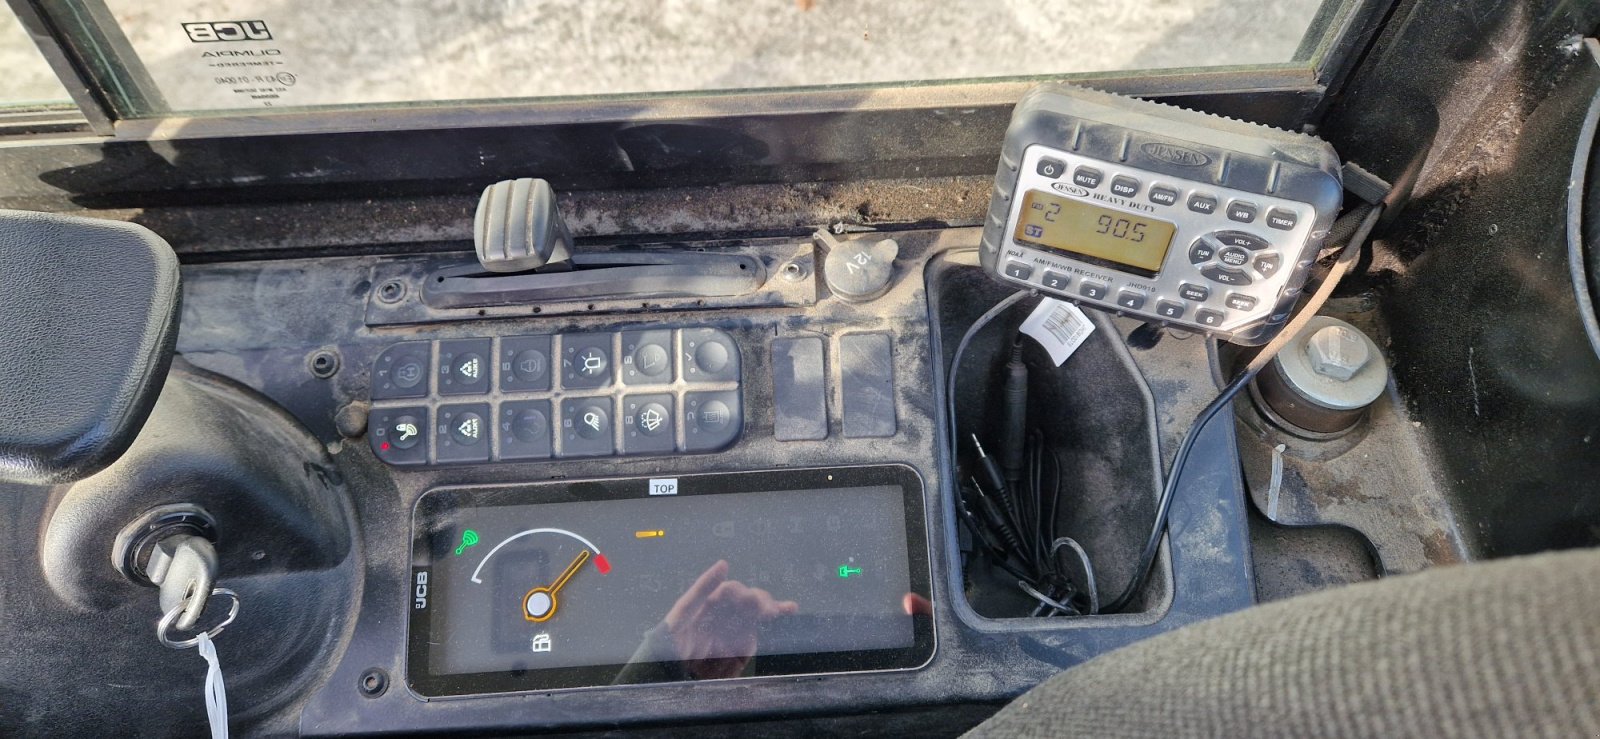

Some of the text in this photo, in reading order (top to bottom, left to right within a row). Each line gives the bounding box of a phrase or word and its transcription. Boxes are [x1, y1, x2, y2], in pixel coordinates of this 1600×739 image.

[1076, 175, 1097, 185] MUTE
[1057, 184, 1084, 195] JENSEN
[1114, 185, 1135, 194] DISP
[1152, 193, 1174, 203] AM/FM
[1093, 193, 1157, 213] HEAVY DUTY
[1193, 202, 1211, 210] AUX
[1044, 203, 1062, 223] 2
[1235, 210, 1250, 219] WB
[1272, 217, 1294, 227] TIMER
[1026, 225, 1043, 238] ST
[1197, 249, 1210, 257] TUN
[1224, 251, 1245, 259] AUDIO
[845, 251, 872, 275] 12V
[1224, 257, 1243, 265] MENU
[1260, 261, 1274, 270] TUN
[1074, 268, 1114, 283] RECEIVER
[1051, 279, 1058, 287] 2
[1089, 289, 1096, 297] 3
[1186, 290, 1204, 298] SEEK
[1127, 299, 1134, 307] 4
[1231, 299, 1250, 307] SEEK
[1166, 308, 1174, 316] 5
[502, 362, 511, 371] 5
[563, 359, 573, 368] 7
[378, 369, 388, 377] 1
[441, 365, 450, 374] 3
[439, 424, 447, 434] 2
[502, 422, 511, 432] 4
[654, 484, 675, 494] TOP
[415, 571, 428, 609] JCB
